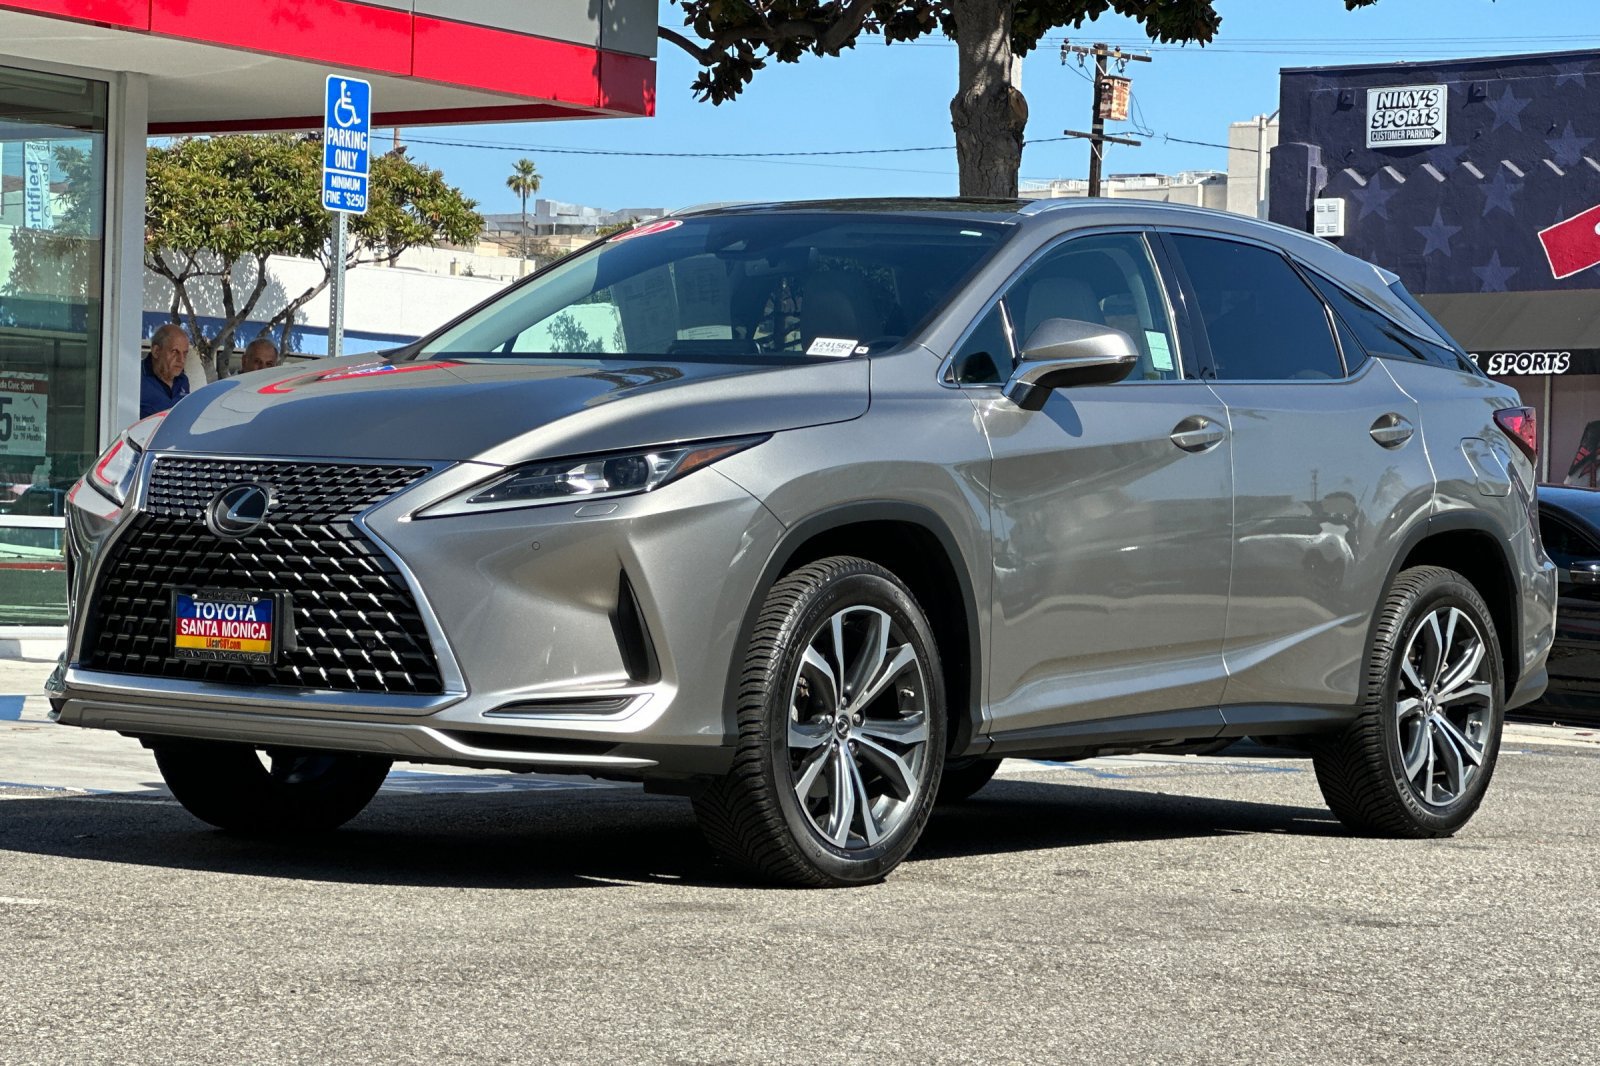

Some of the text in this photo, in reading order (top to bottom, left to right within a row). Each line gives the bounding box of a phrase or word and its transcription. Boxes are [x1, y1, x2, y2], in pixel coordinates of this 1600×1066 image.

[1376, 89, 1439, 110] NIKY'S
[1371, 107, 1440, 129] SPORTS
[327, 127, 367, 150] PARKING
[1371, 128, 1435, 141] CUSTOMER PARKING
[334, 148, 358, 170] ONLY
[330, 175, 361, 191] MINIMUM
[26, 161, 41, 230] ertified
[325, 191, 341, 204] FINE
[1487, 352, 1571, 375] SPORTS
[193, 602, 257, 622] TOYOTA
[181, 618, 267, 639] SANTA MONICA
